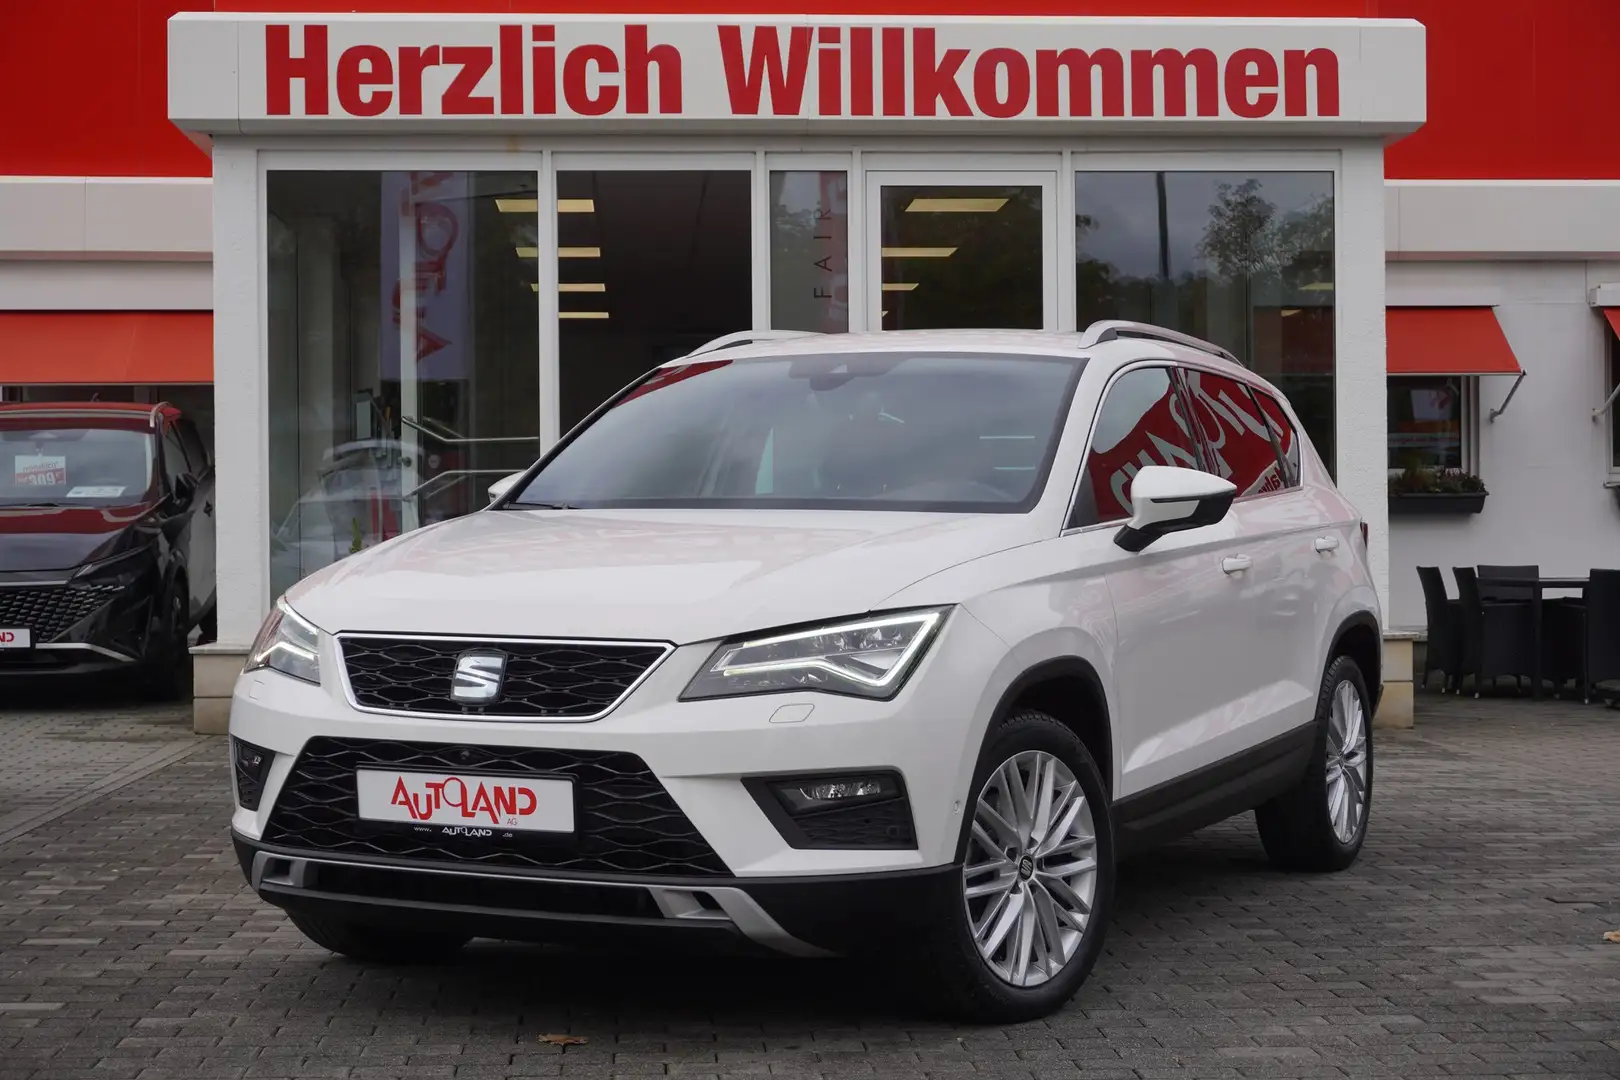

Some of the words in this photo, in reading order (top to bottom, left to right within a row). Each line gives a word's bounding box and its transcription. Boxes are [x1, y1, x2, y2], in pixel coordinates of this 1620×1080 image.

[264, 23, 682, 116] Herzlich
[716, 24, 1340, 118] Willkommen
[813, 206, 833, 299] FAIR
[506, 817, 518, 826] AG
